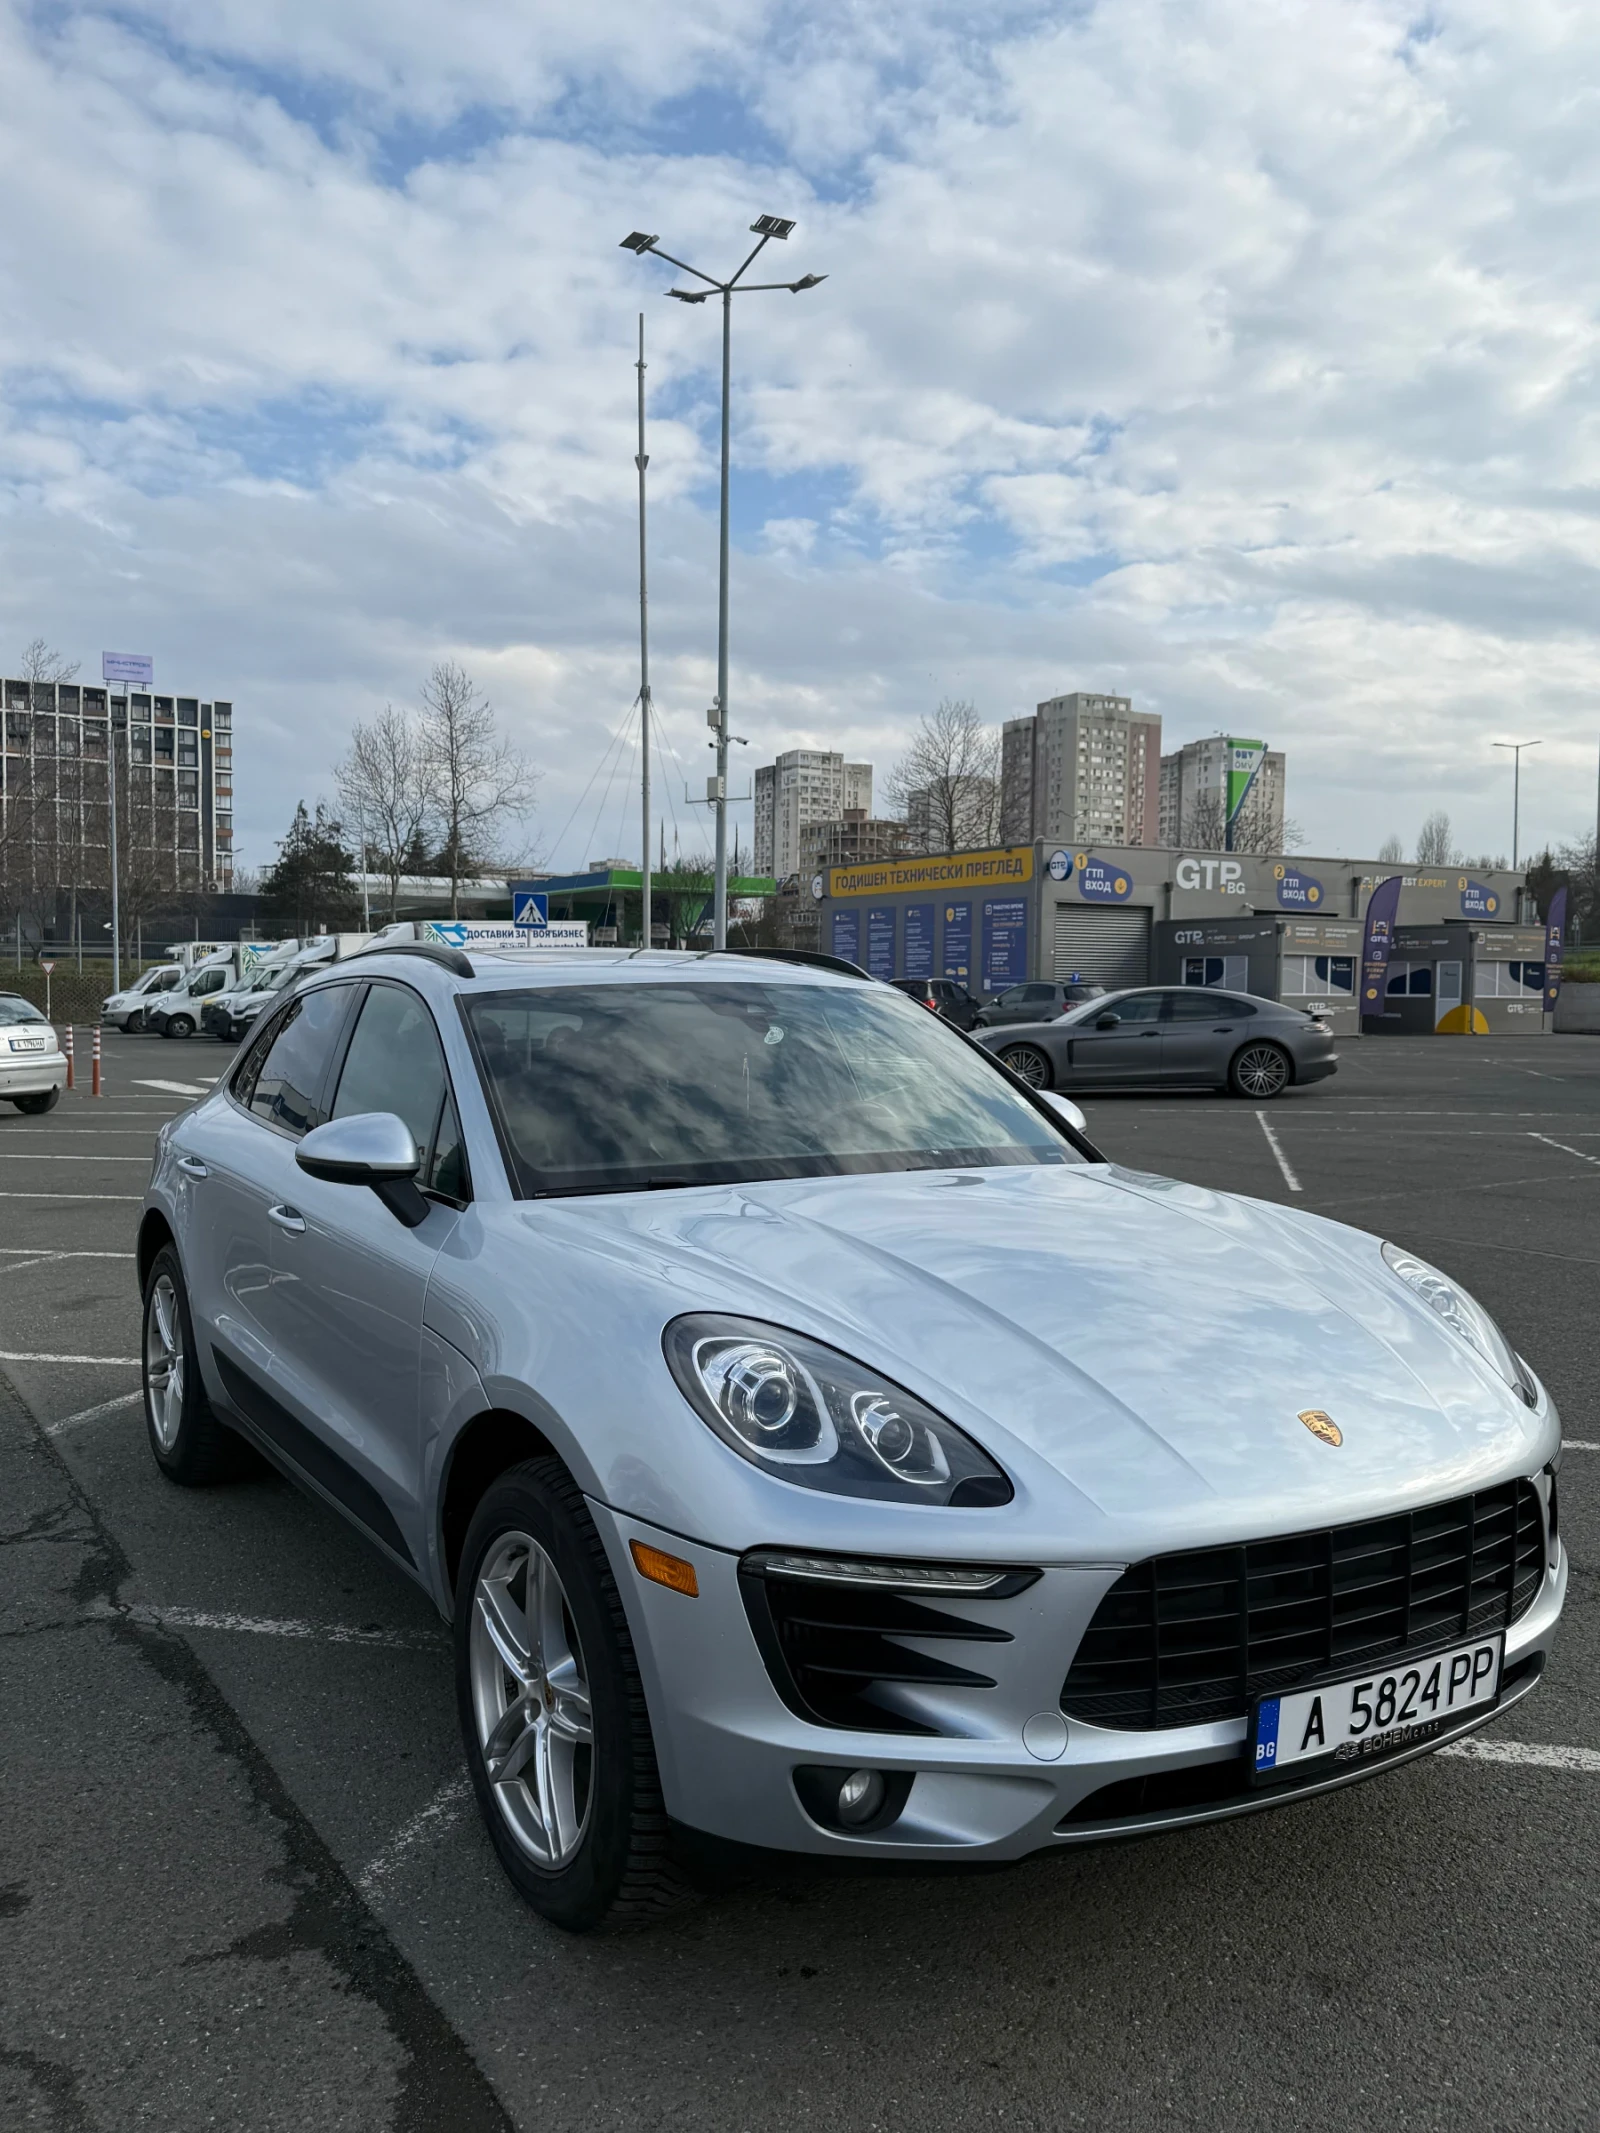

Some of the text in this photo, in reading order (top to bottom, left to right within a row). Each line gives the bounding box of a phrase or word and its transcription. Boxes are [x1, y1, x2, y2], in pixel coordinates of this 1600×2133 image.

[1235, 761, 1253, 769] OMV
[1078, 855, 1083, 867] 1
[835, 858, 1023, 891] ГОДИШЕН ТЕХНИЧЕСКИ ПРЕГЛЕД
[1086, 868, 1104, 878] ГТП
[1276, 866, 1282, 878] 2
[1085, 880, 1112, 893] ВХОД
[1283, 878, 1299, 888] ГТП
[1418, 878, 1448, 888] EXPERT
[1460, 879, 1466, 888] 3
[1282, 889, 1305, 901] ВХОД
[1465, 889, 1480, 898] ГТП
[1465, 899, 1485, 911] ВХОД
[467, 929, 514, 940] ДОСТАВКИ
[516, 929, 527, 938] ЗА
[552, 929, 584, 938] БИЗНЕС
[1256, 1741, 1276, 1760] BG
[1300, 1695, 1326, 1751] A
[1363, 1722, 1439, 1754] BOHEM CARS
